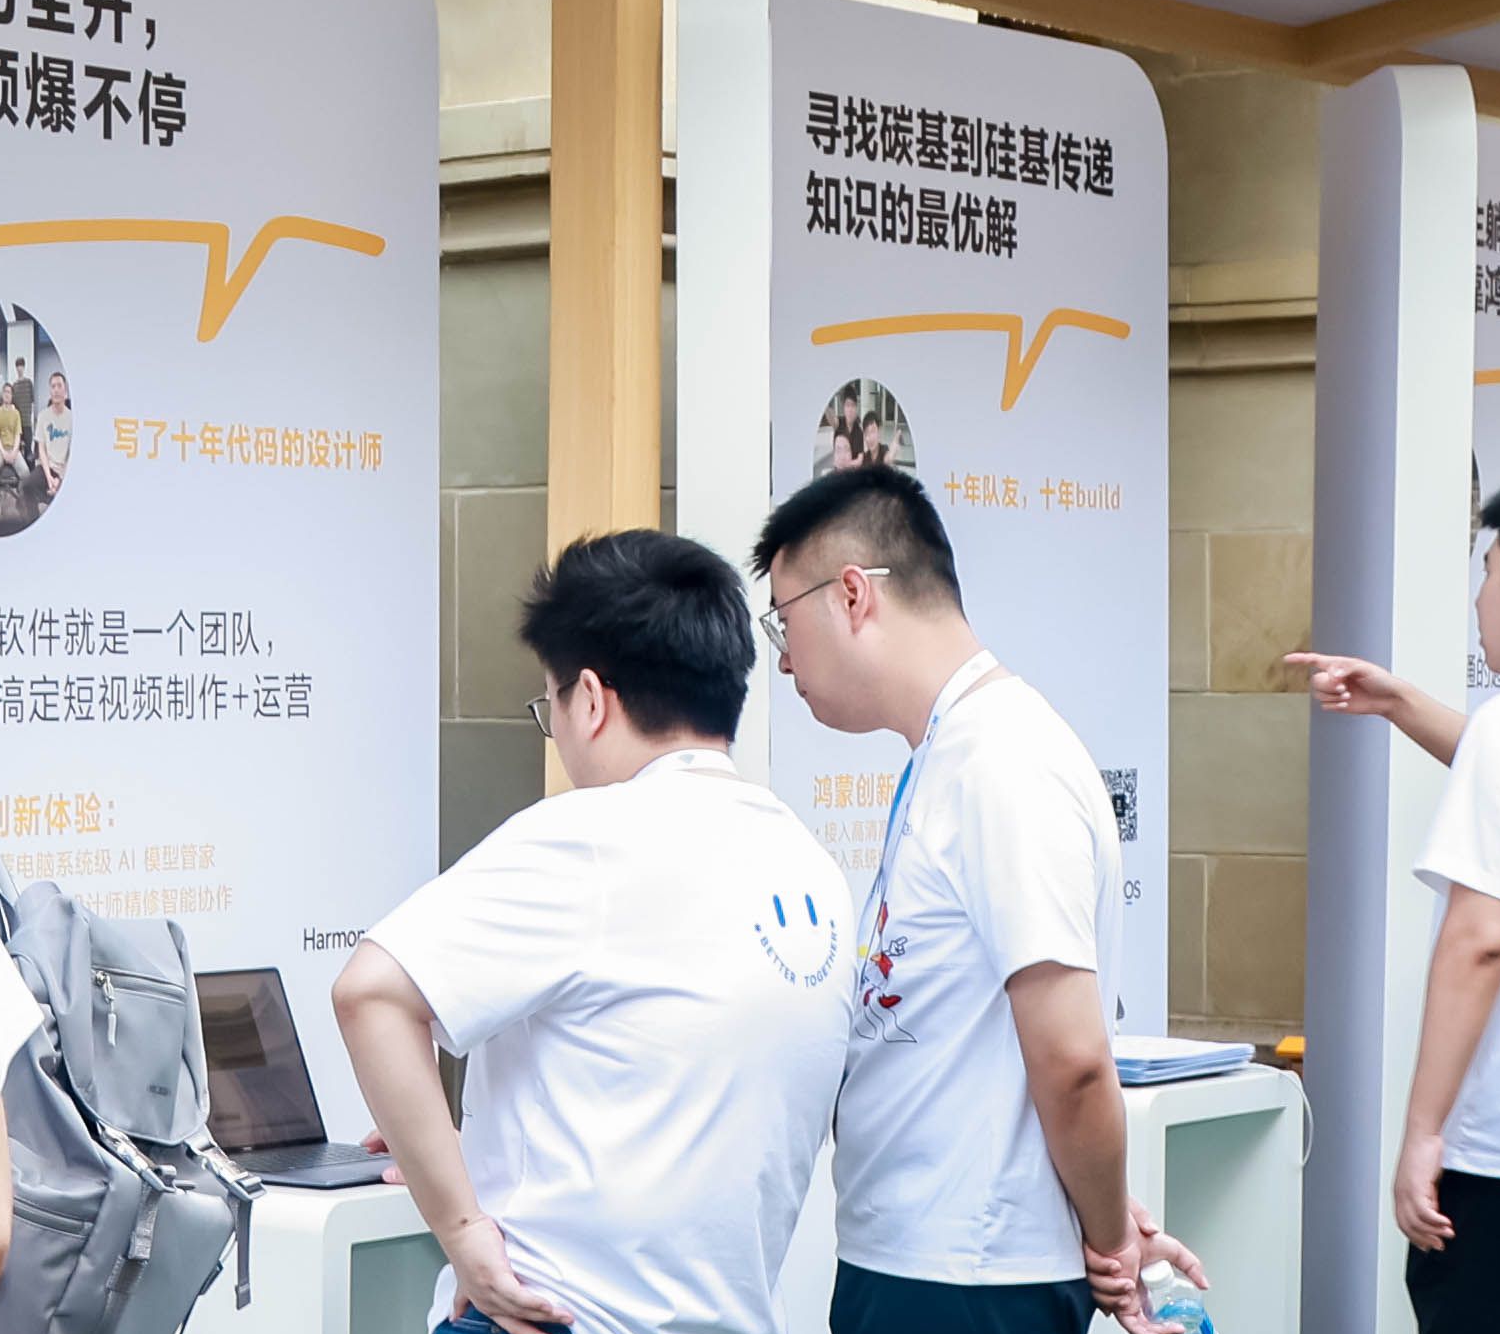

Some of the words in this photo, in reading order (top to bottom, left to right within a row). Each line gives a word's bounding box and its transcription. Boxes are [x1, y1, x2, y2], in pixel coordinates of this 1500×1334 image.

[805, 90, 1115, 197] 寻找碳基到硅基传递
[805, 170, 1018, 259] 知识的最优解
[113, 418, 383, 471] 写了十年代码的设计师
[760, 935, 797, 986] BETTER
[803, 930, 839, 989] TOGETHER
